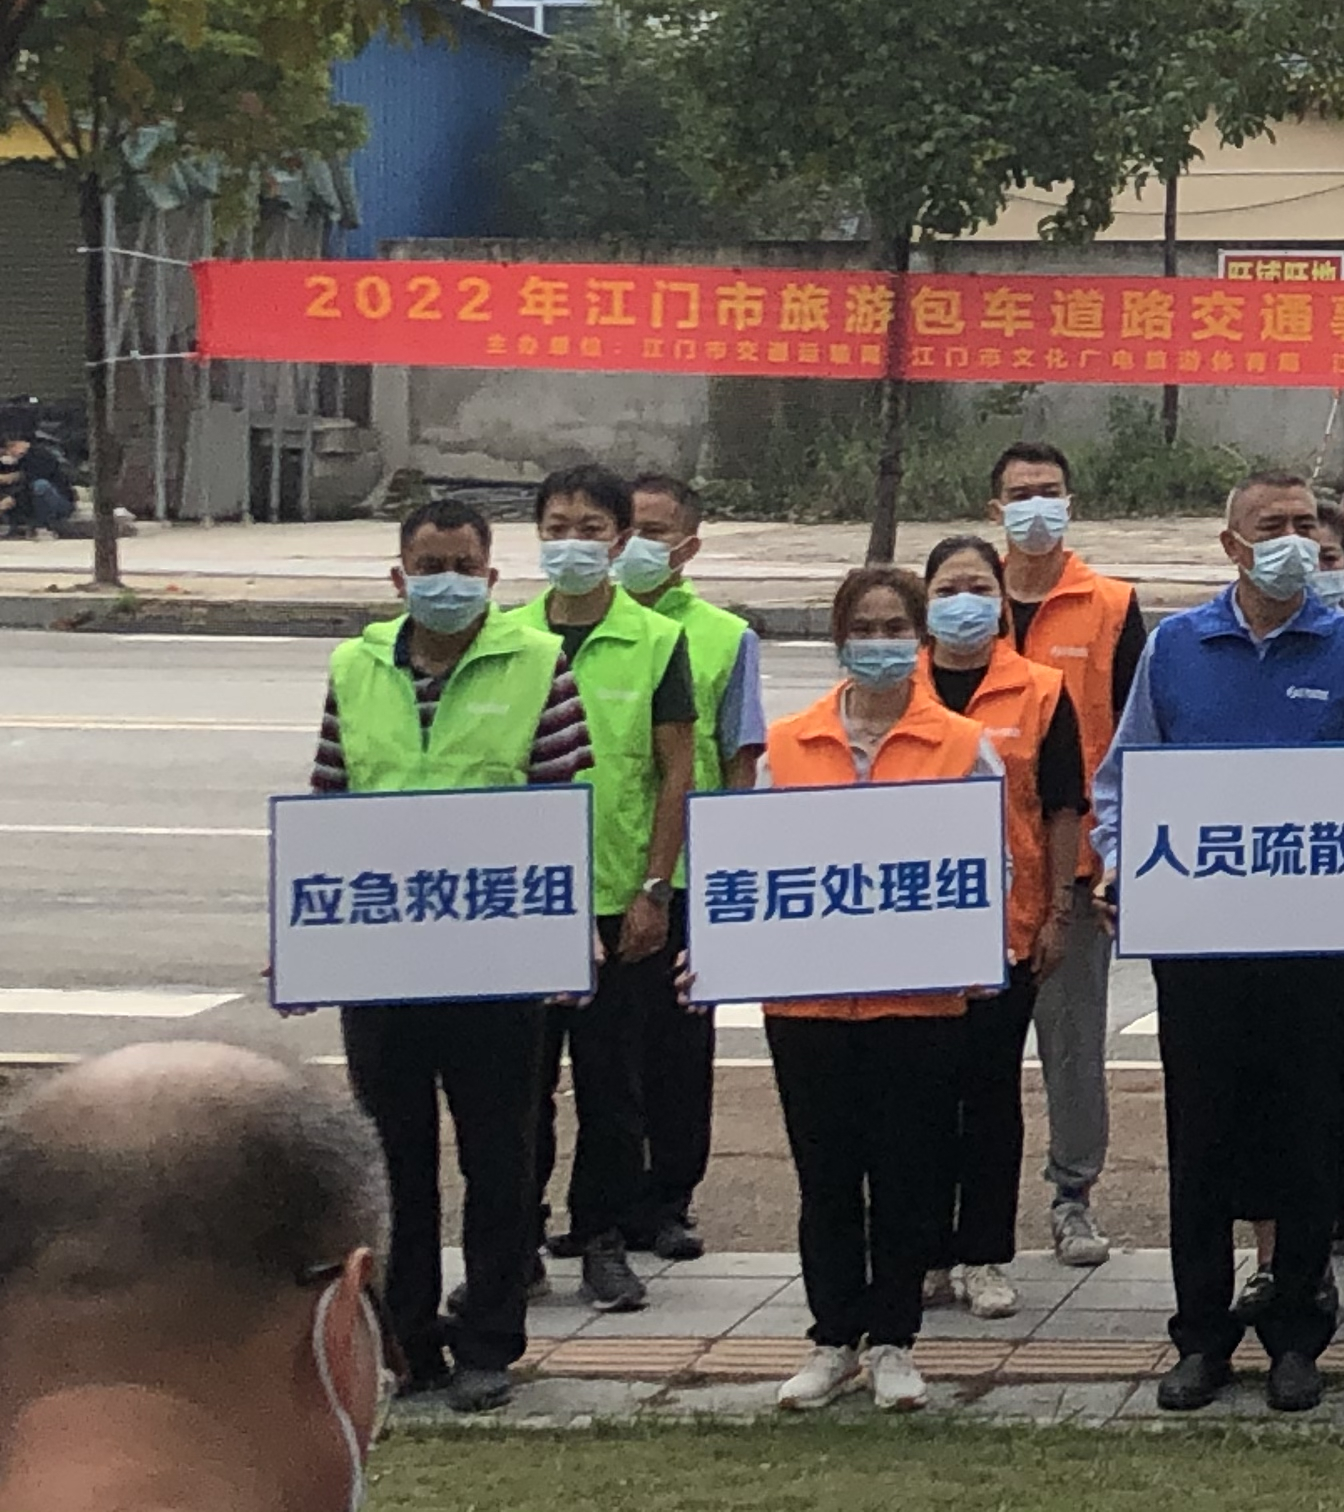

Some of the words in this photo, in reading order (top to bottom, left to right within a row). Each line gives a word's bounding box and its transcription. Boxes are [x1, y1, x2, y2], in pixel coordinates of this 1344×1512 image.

[290, 864, 577, 926] 应急救援组
[704, 857, 991, 924] 善后处理组
